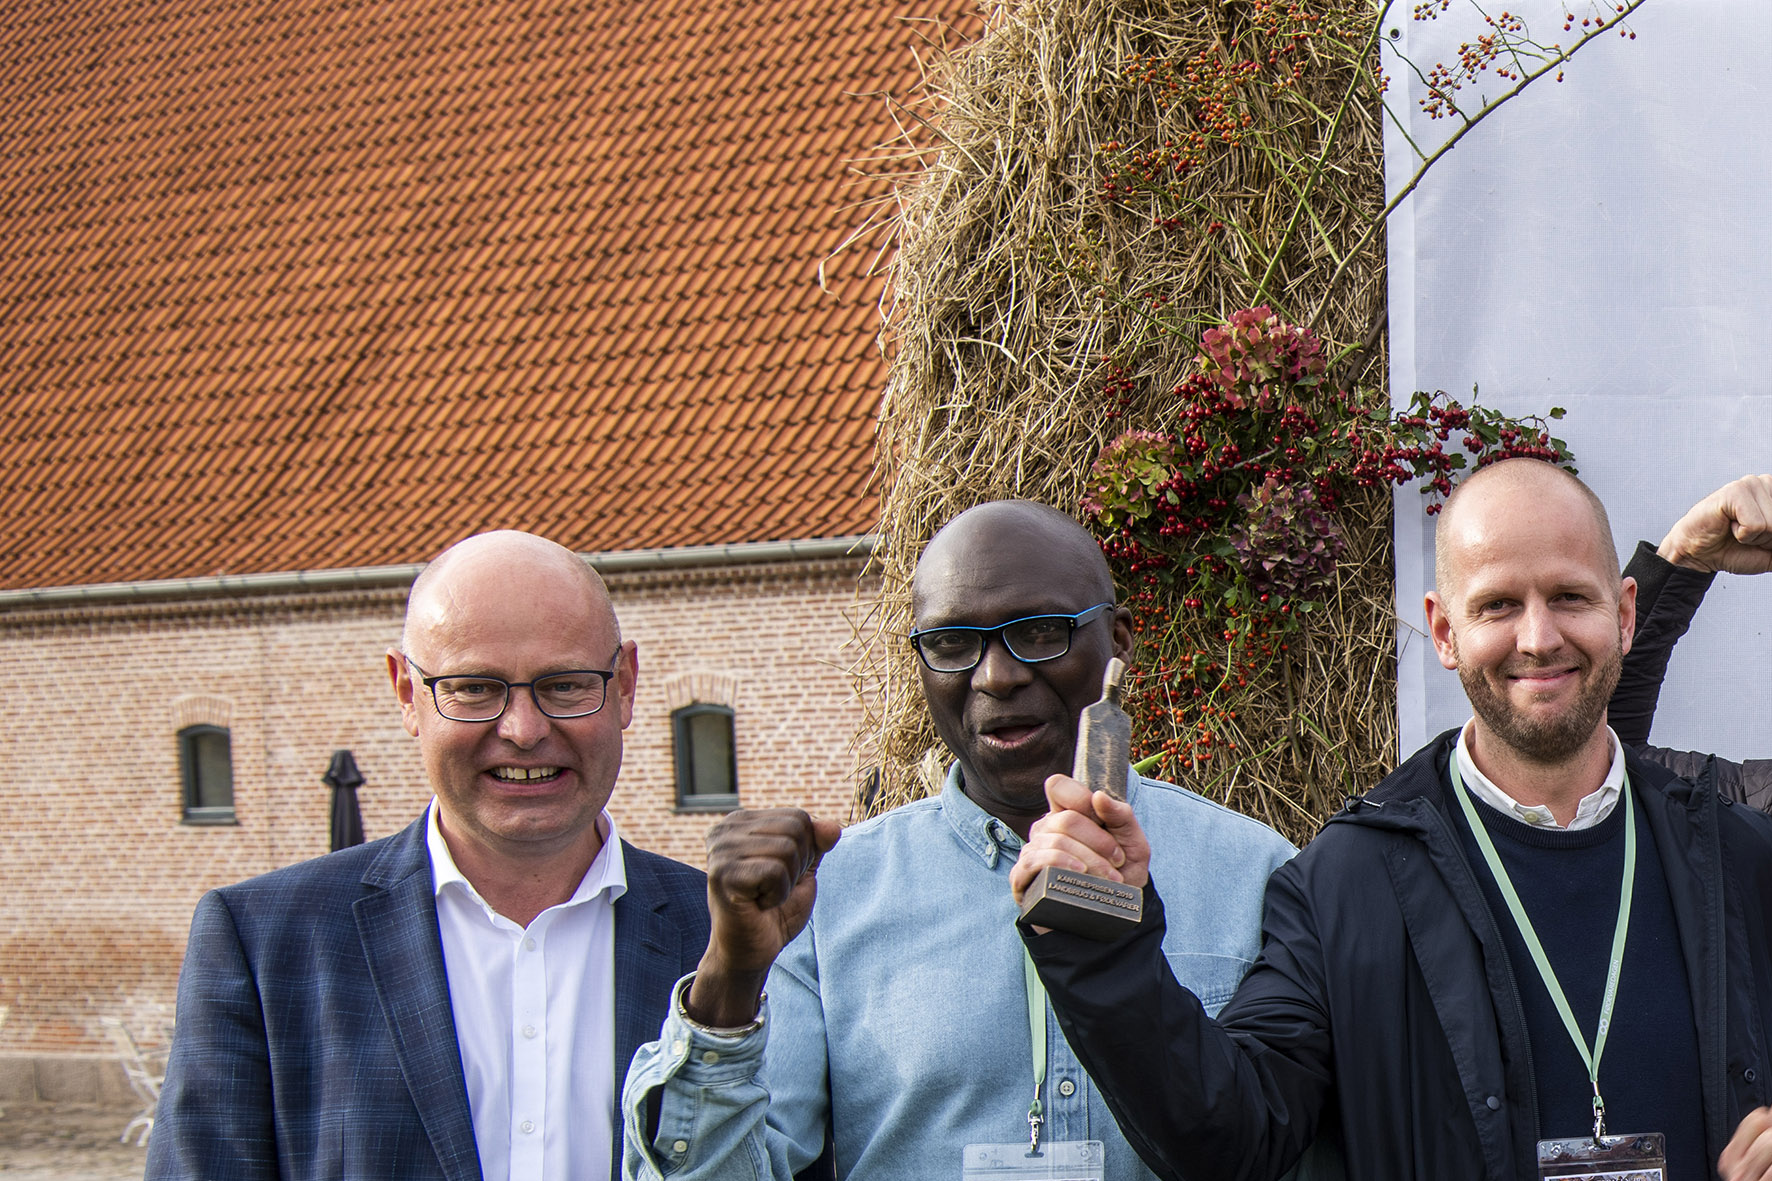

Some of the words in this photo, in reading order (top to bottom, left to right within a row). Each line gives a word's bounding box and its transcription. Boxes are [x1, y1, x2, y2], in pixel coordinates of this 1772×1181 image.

[1048, 882, 1088, 899] LANDBRUG
[1057, 874, 1114, 895] KANTINEPRISEN
[1116, 890, 1134, 900] 2019
